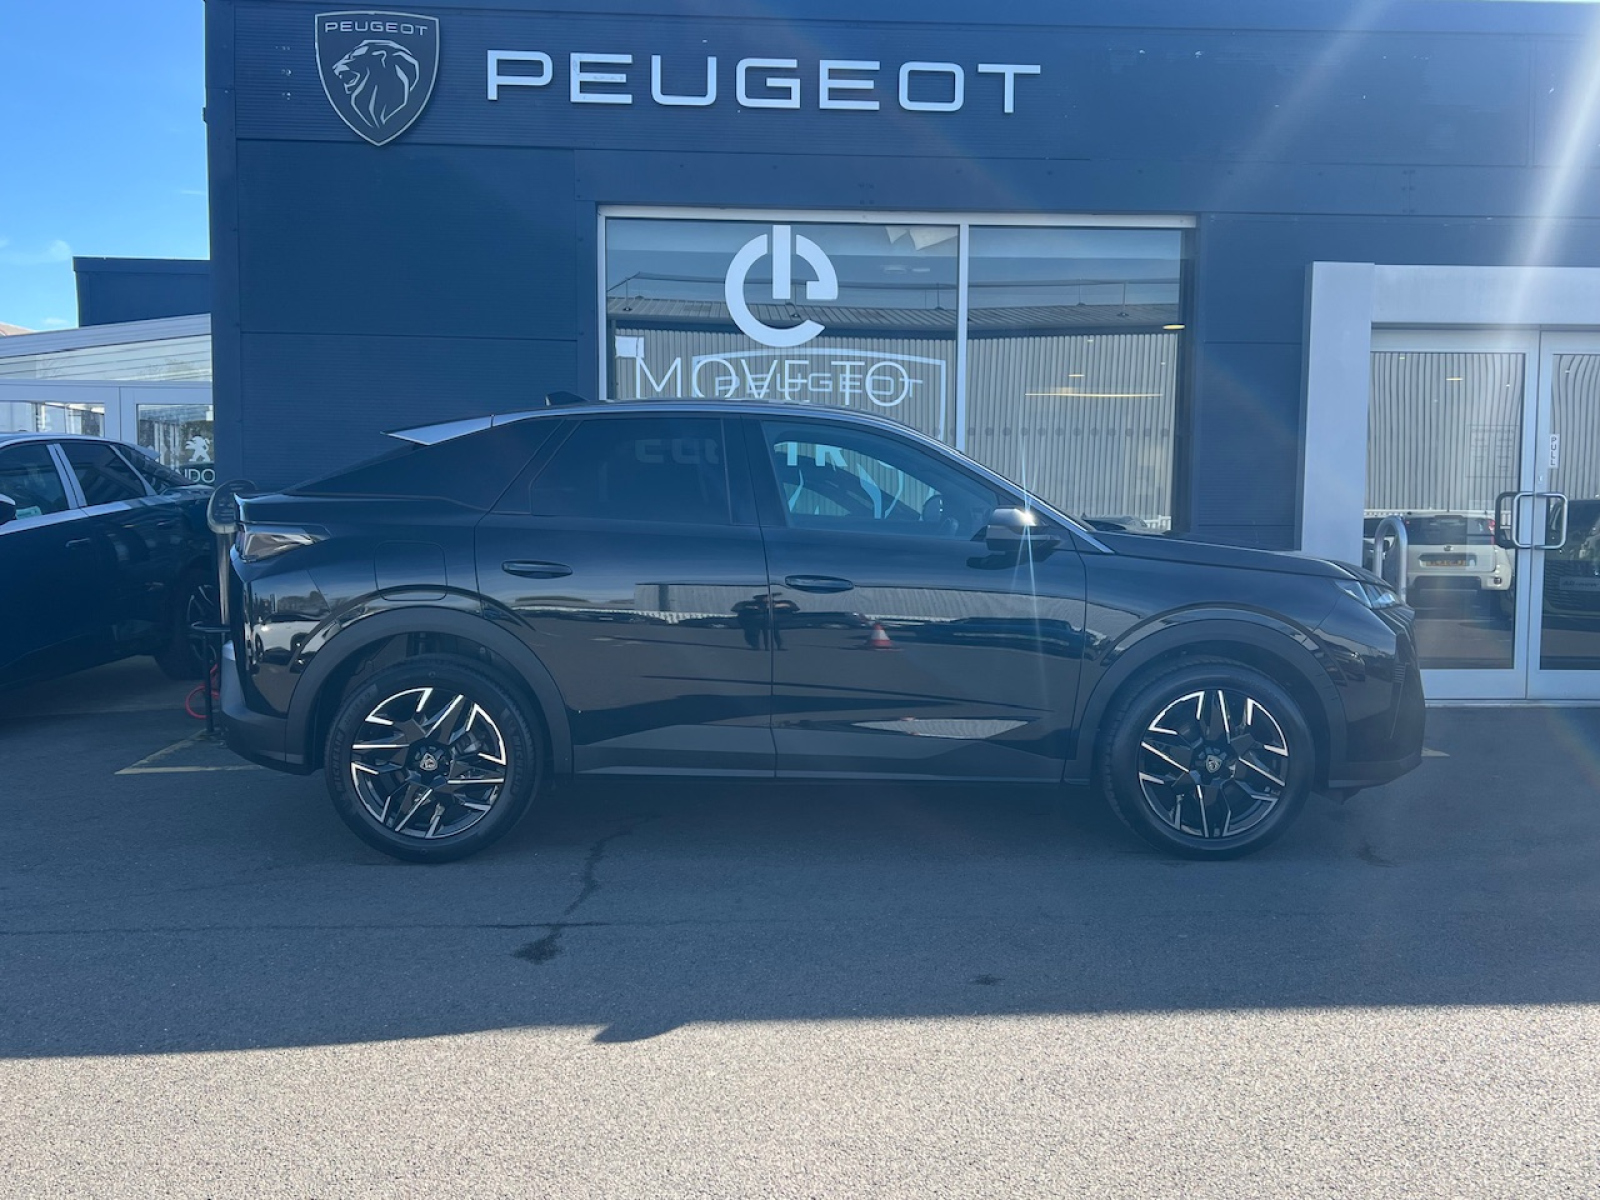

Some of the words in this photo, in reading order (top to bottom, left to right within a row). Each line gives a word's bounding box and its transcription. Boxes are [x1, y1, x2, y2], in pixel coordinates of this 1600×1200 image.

[325, 20, 428, 36] PEUGEOT
[487, 49, 1041, 113] PEUGEOT
[635, 356, 810, 402] MOVE
[831, 359, 910, 407] TO
[714, 372, 924, 398] PEUGEOT
